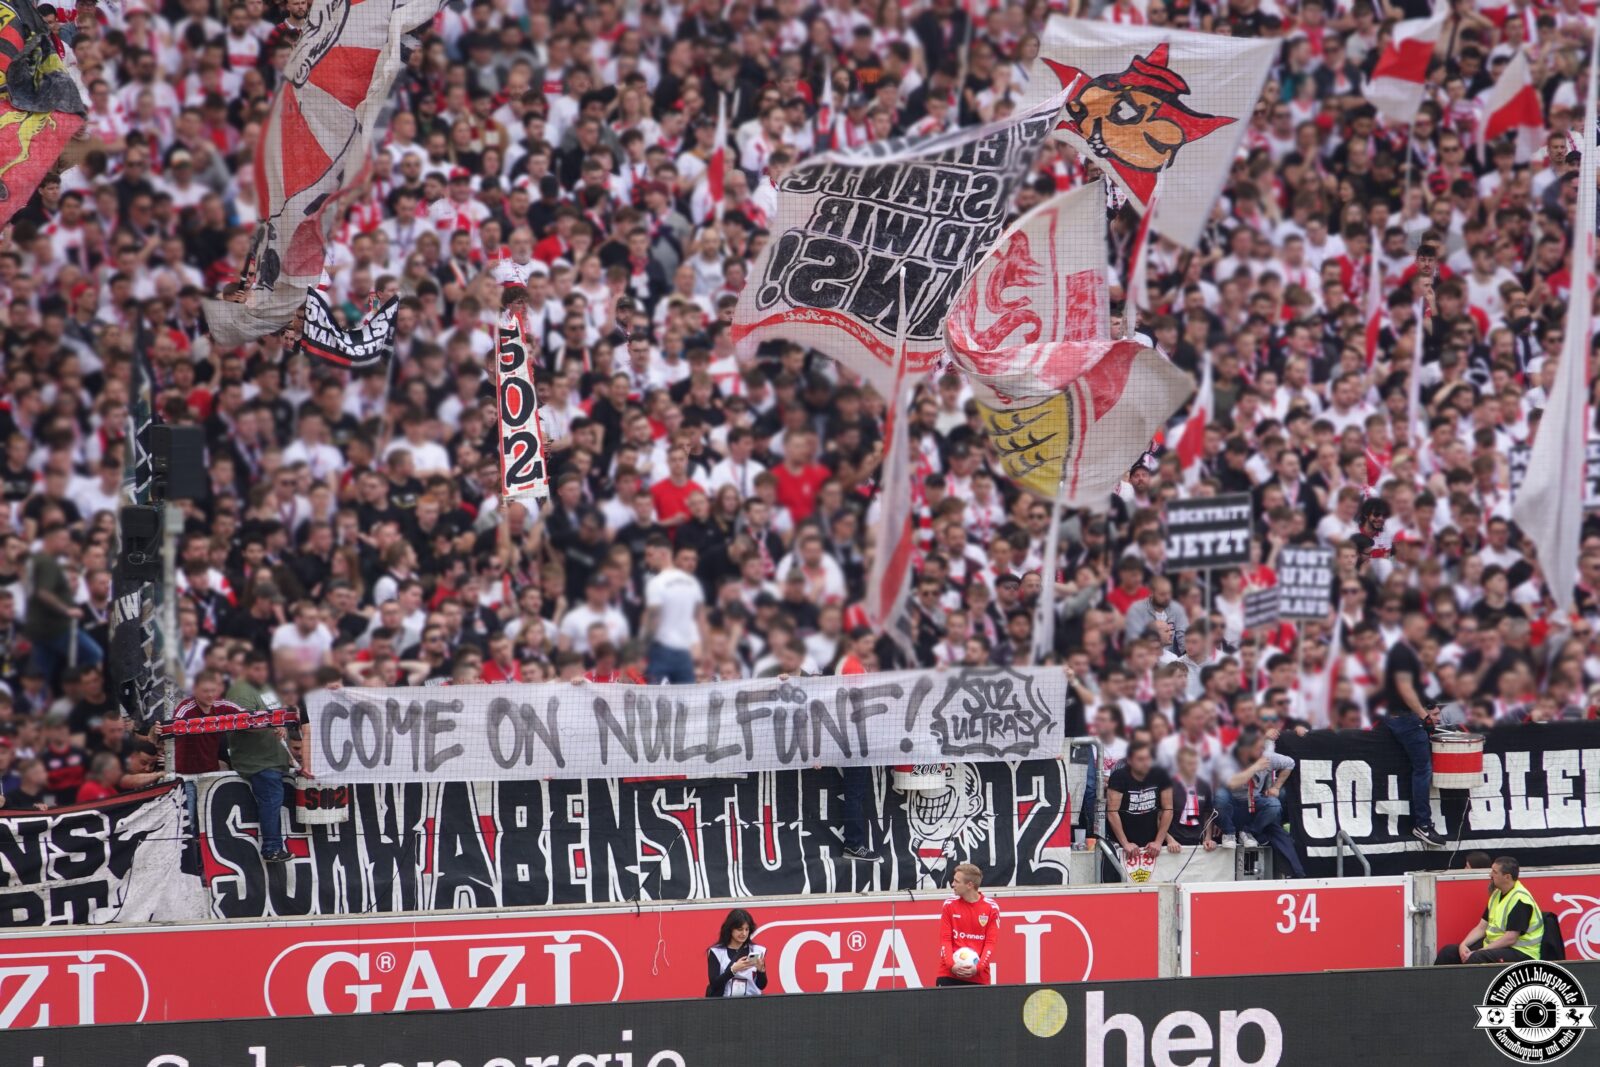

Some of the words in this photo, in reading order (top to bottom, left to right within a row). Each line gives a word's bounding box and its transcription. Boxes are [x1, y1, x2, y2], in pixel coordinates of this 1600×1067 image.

[1166, 528, 1250, 559] JETZT
[1281, 567, 1332, 585] UND
[320, 697, 464, 772] COME
[487, 696, 565, 769] ON
[951, 709, 1035, 745] ULTRAS
[1276, 893, 1321, 934] 34
[1085, 991, 1283, 1067] hep
